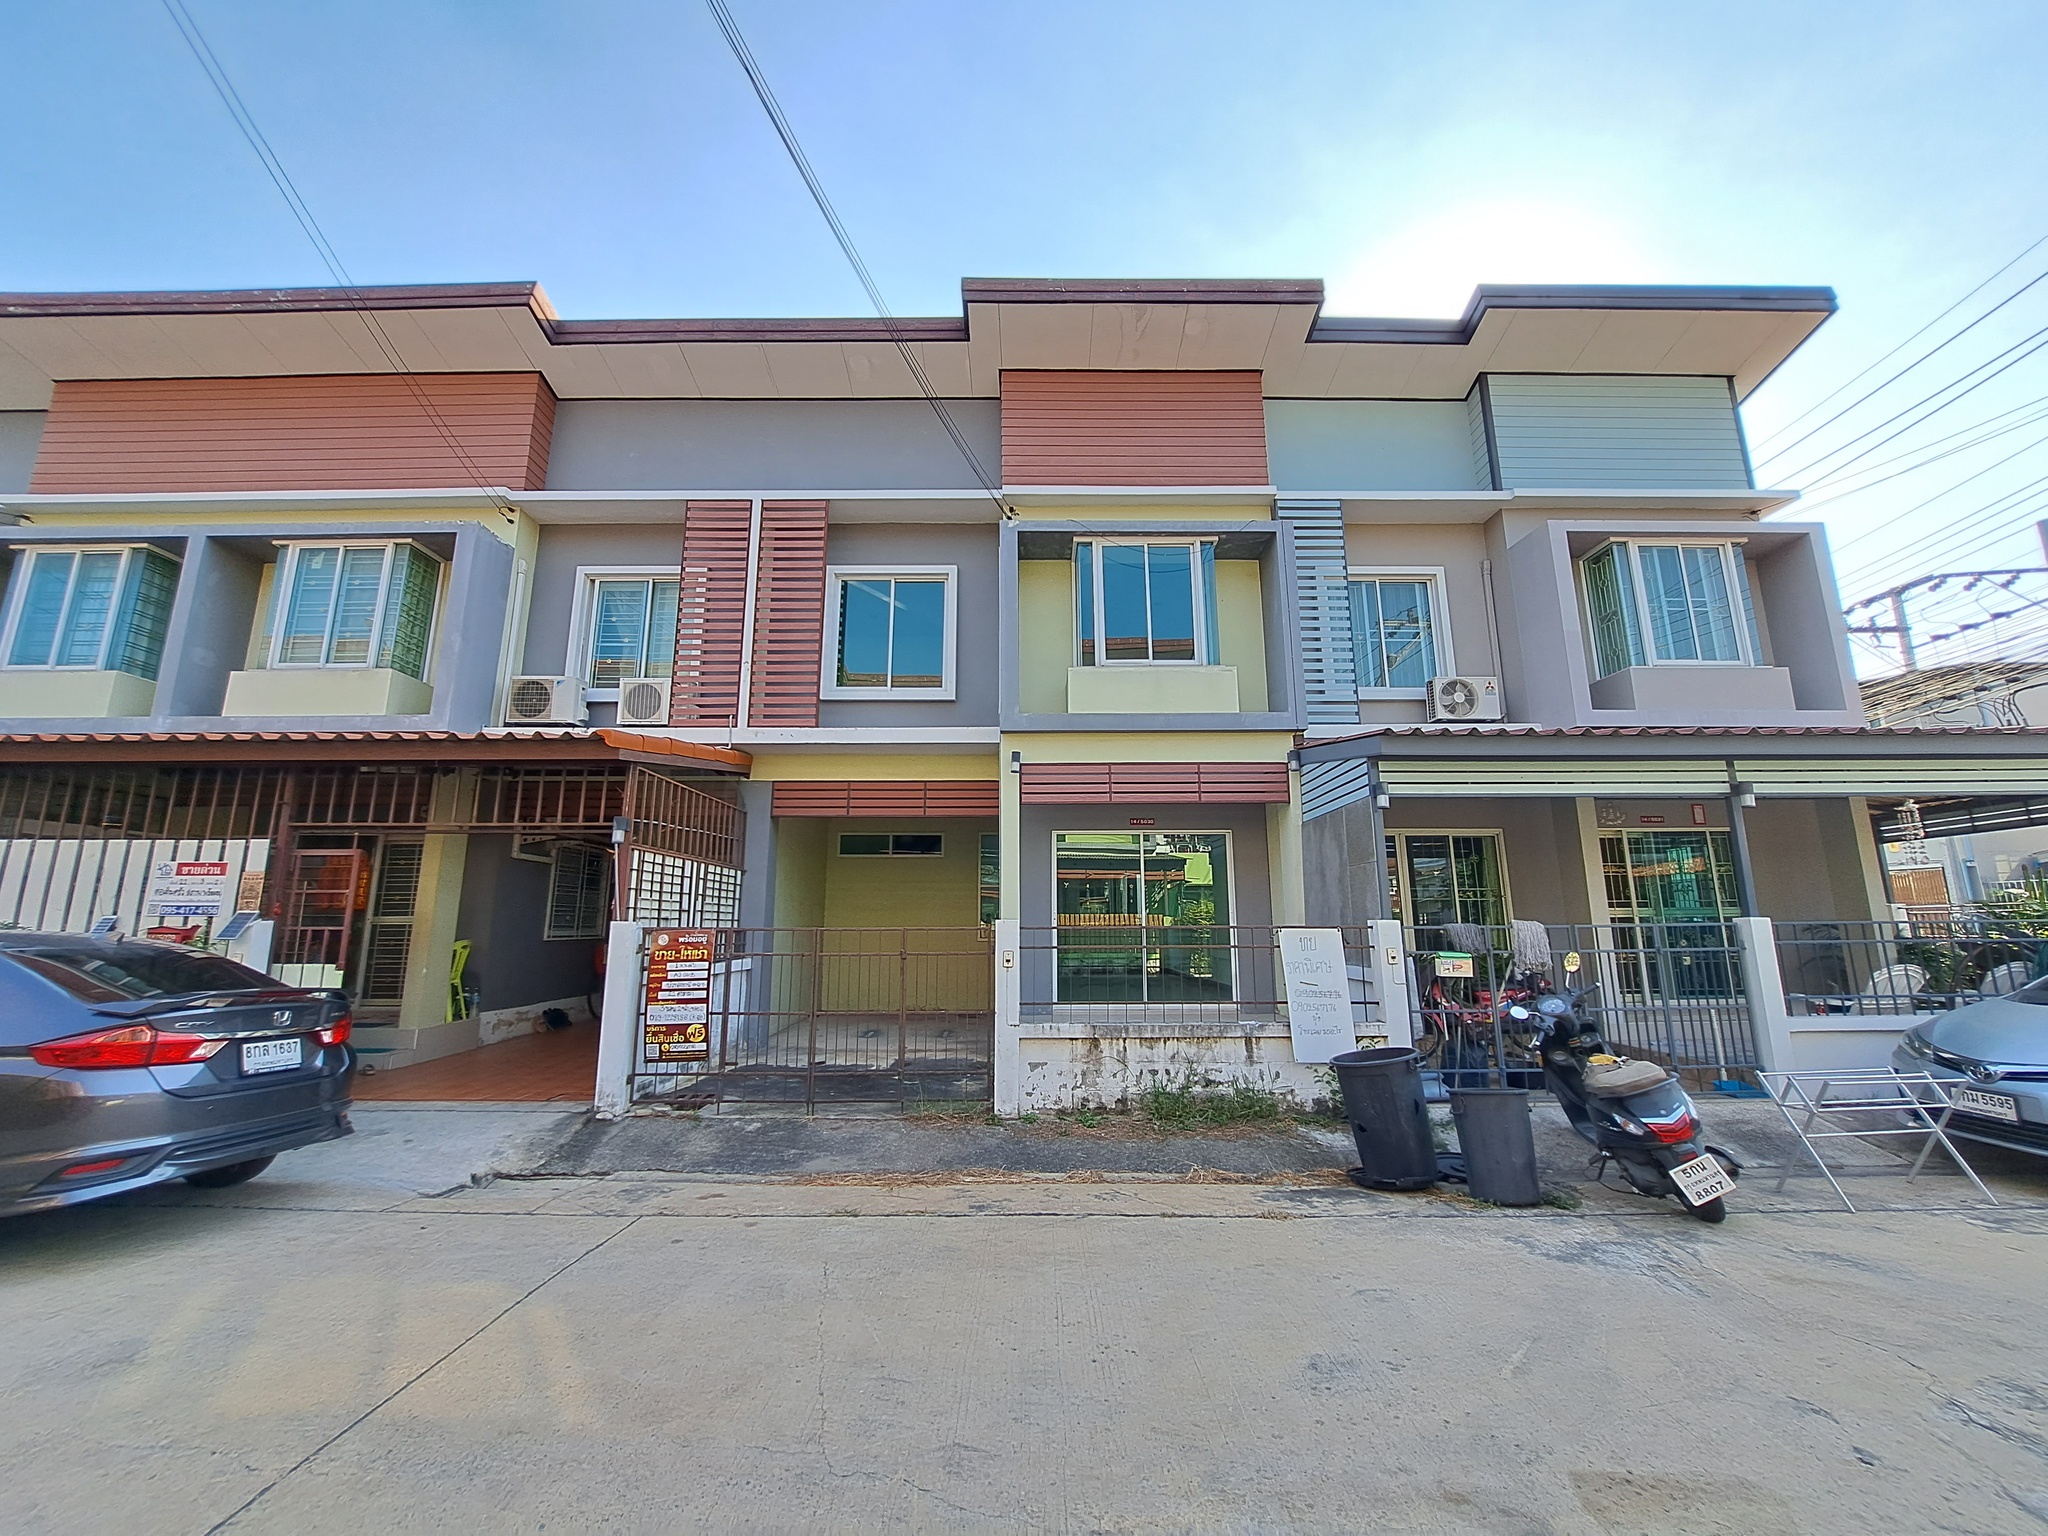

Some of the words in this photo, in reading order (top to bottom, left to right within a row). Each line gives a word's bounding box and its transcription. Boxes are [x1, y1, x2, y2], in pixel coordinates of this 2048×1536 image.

[181, 863, 221, 875] ขายด่วน
[654, 945, 708, 961] ขาย-ให้เช่า
[645, 1030, 685, 1044] ยื่นสินเชื่อ
[246, 1044, 270, 1059] 8กล
[272, 1041, 298, 1055] 1637
[1961, 1090, 1980, 1104] กม
[1981, 1094, 2013, 1110] 5595
[1695, 1180, 1725, 1200] 8807
